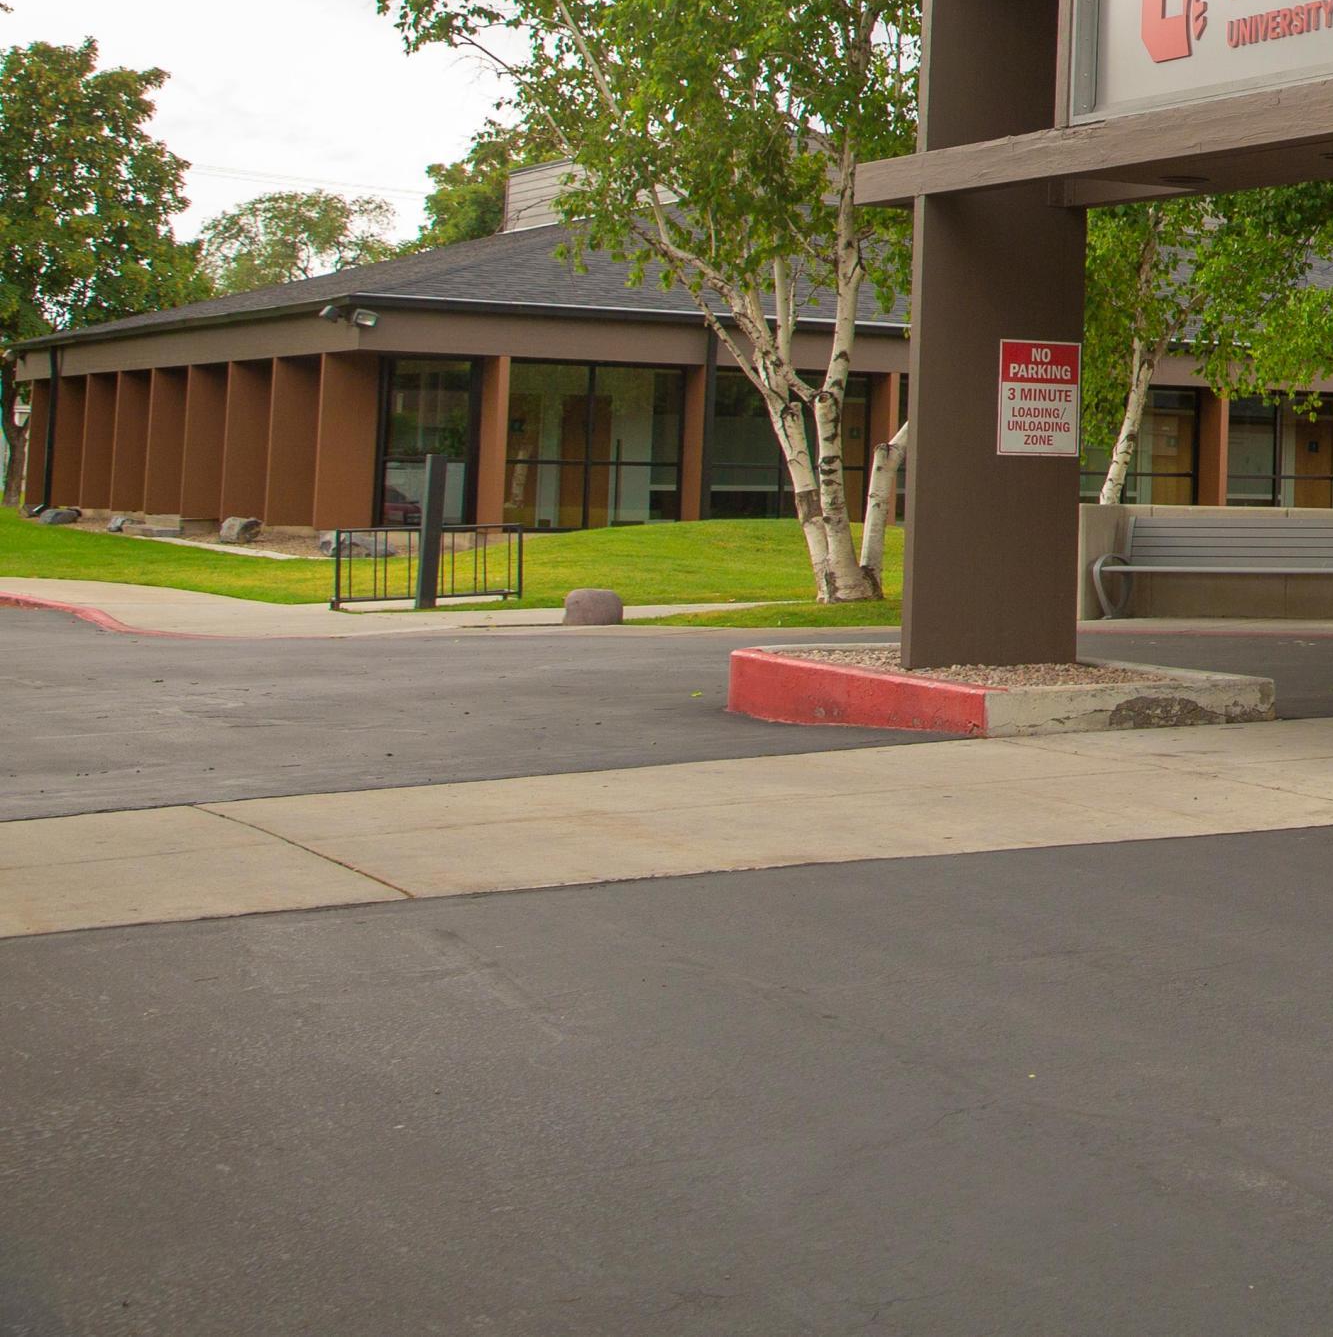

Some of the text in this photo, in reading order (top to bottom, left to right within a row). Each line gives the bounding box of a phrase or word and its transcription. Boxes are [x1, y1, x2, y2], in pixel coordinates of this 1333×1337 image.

[1031, 348, 1051, 362] NO
[1010, 364, 1071, 380] PARKING
[1008, 388, 1072, 402] 3 MINUTE
[1012, 407, 1066, 420] LOADING/
[1008, 421, 1070, 432] UNLOADING
[1024, 435, 1053, 445] ZONE
